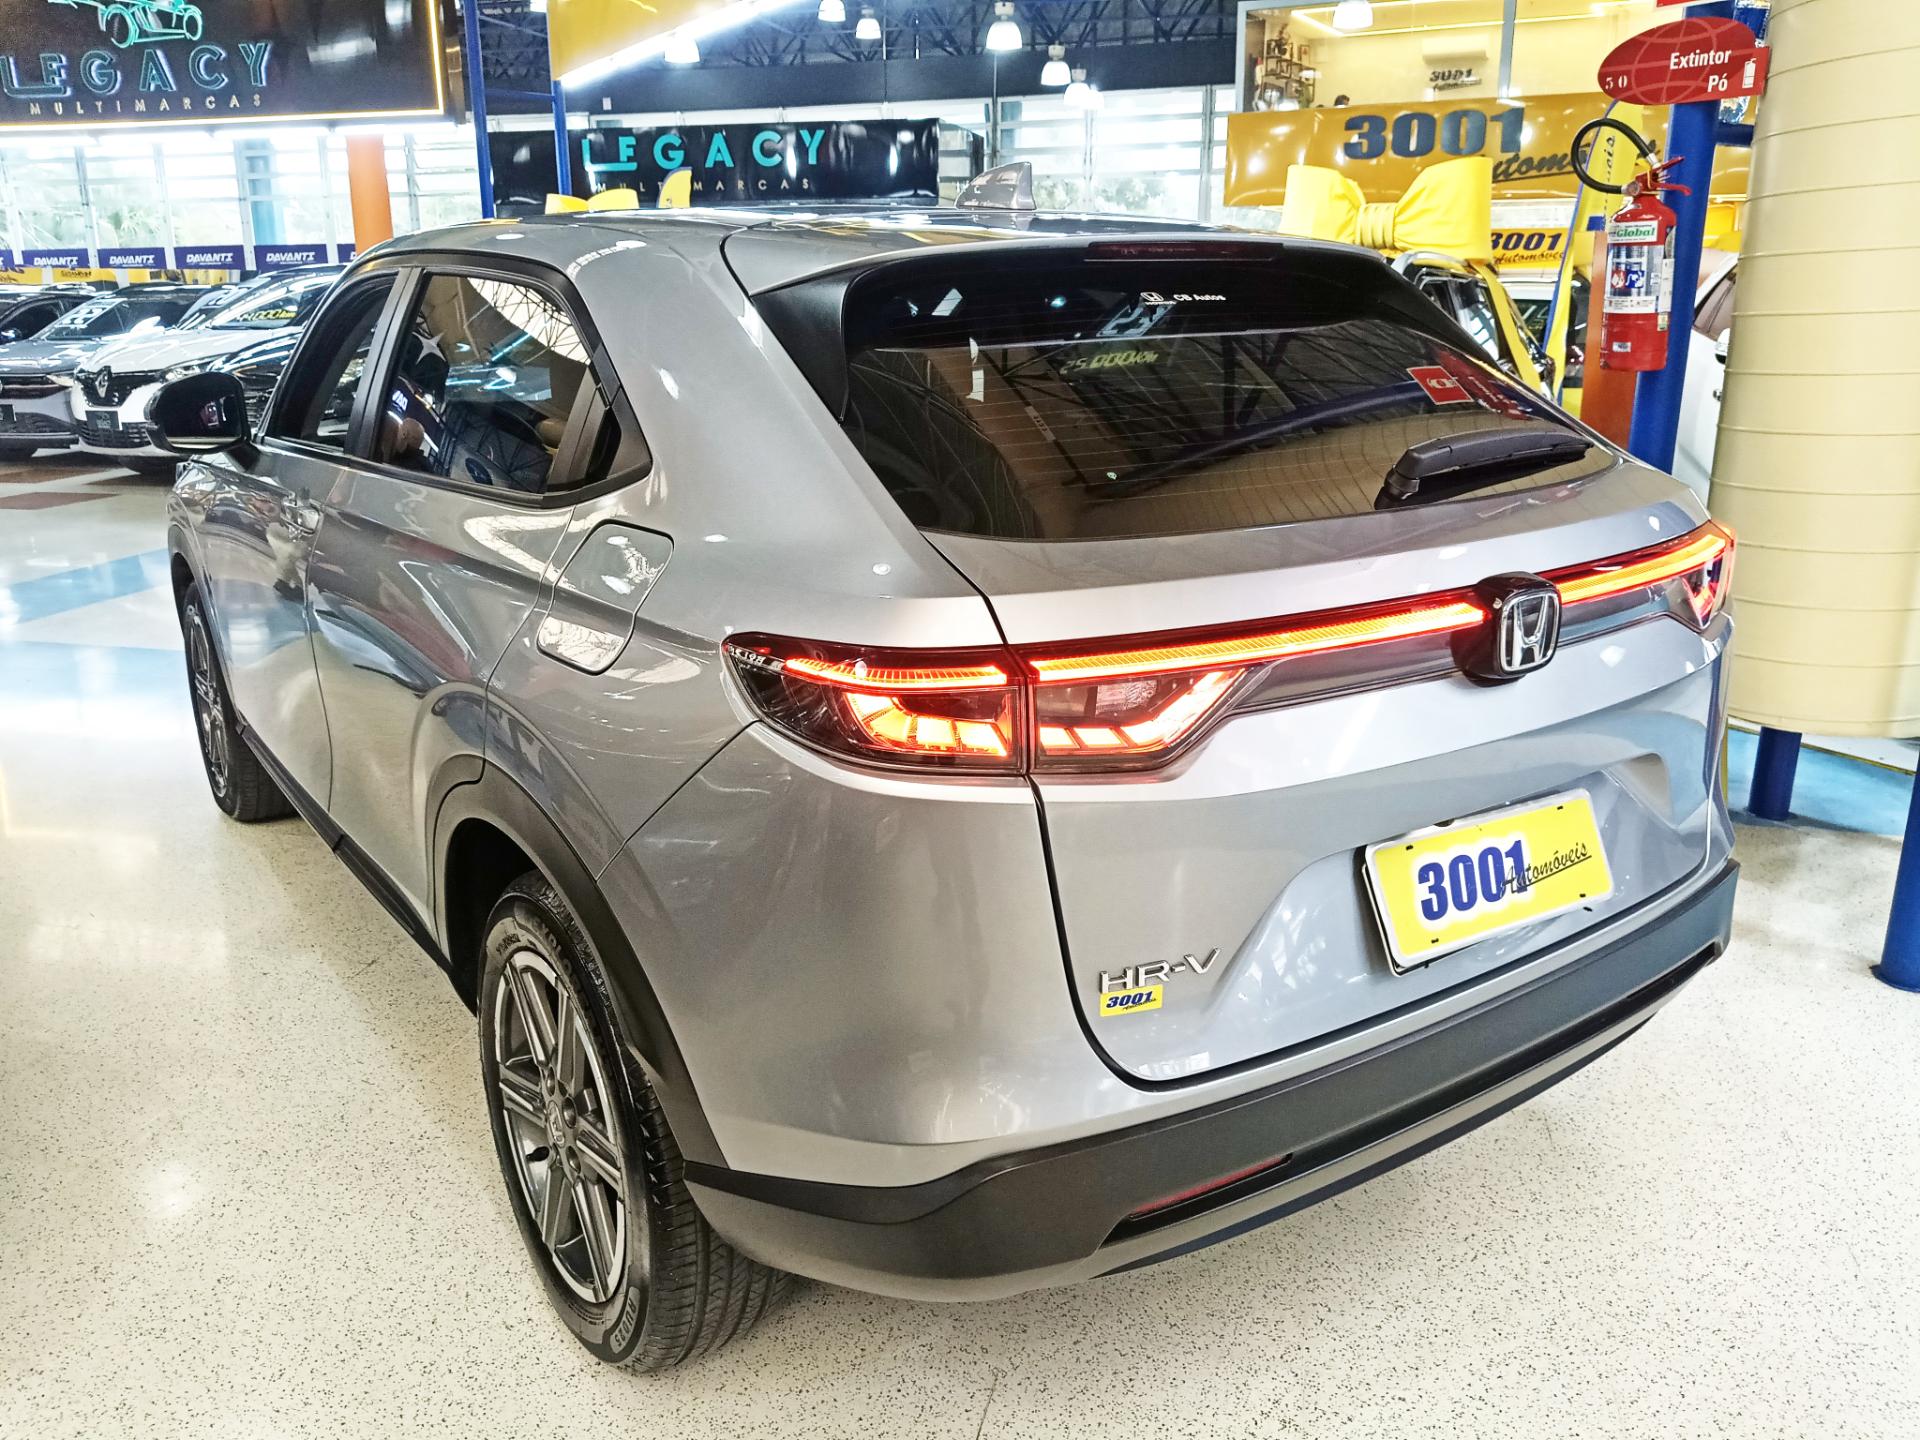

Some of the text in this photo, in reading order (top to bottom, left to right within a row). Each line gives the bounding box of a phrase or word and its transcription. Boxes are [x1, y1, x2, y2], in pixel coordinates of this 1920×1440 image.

[0, 42, 271, 98] LEGACY
[1669, 49, 1732, 70] Extintor
[1707, 73, 1728, 92] Pó
[29, 94, 262, 116] MULTIMARCAS
[1343, 106, 1526, 160] 3001
[581, 129, 826, 172] LEGACY
[599, 178, 810, 193] MULTMARCAS
[1490, 231, 1563, 252] 3001
[1616, 226, 1656, 238] Global
[1417, 839, 1593, 921] 3001 Automóveis
[1100, 947, 1222, 995] HR-V
[1106, 990, 1153, 1009] 3001
